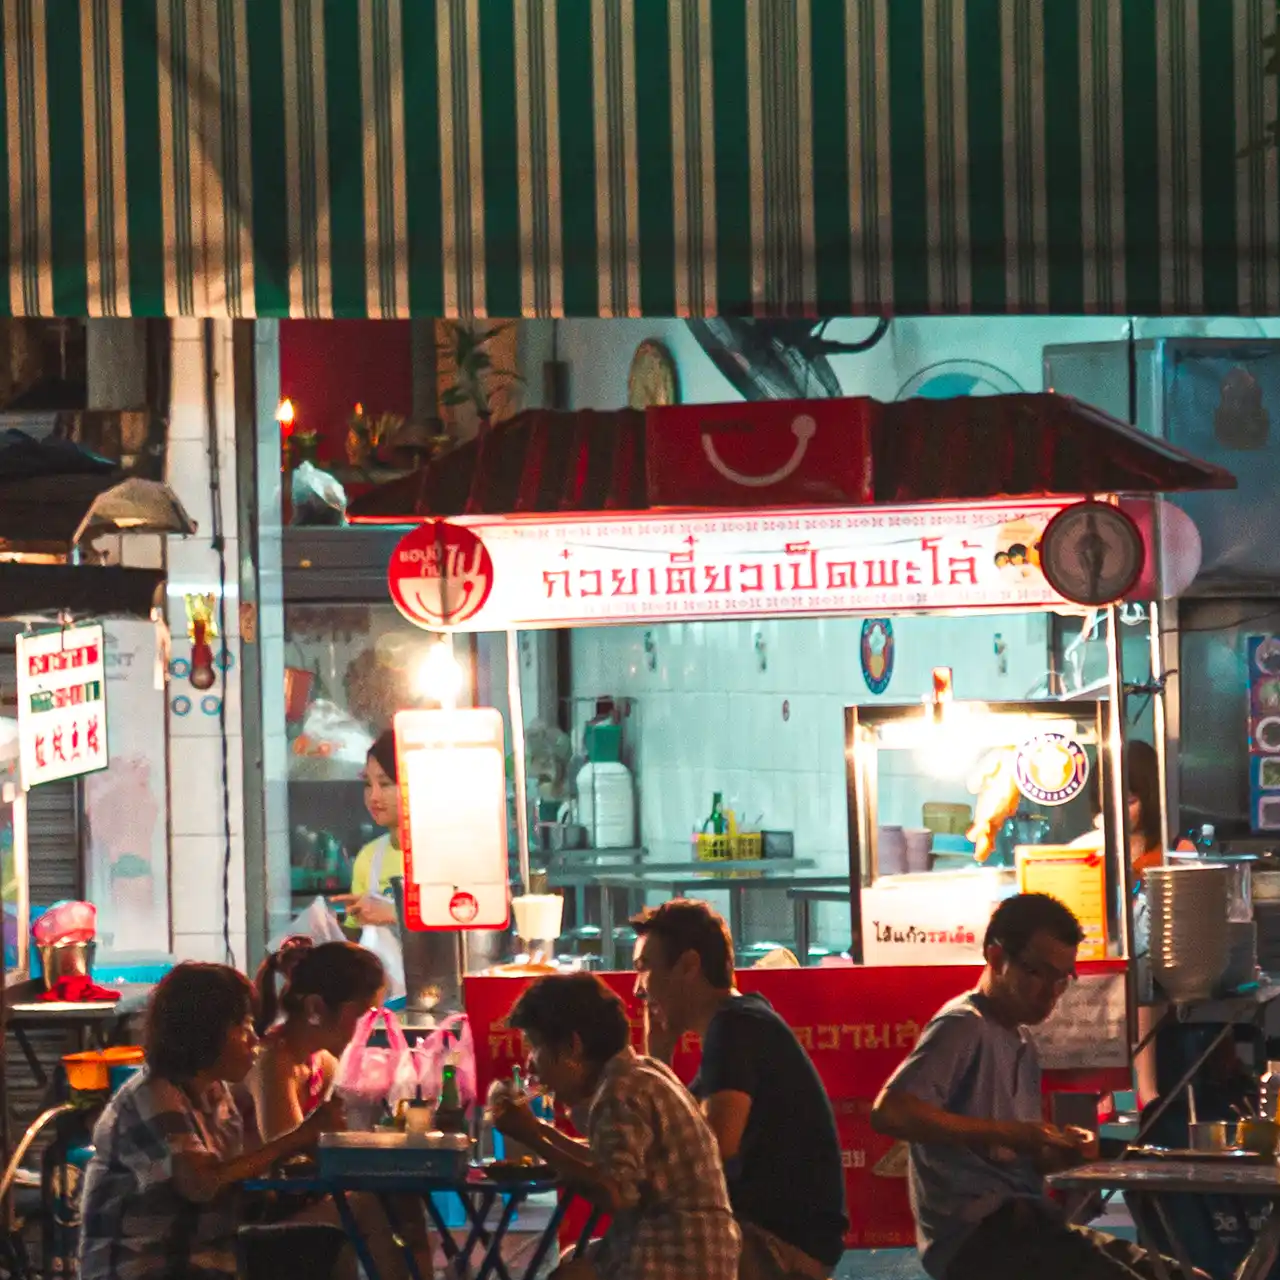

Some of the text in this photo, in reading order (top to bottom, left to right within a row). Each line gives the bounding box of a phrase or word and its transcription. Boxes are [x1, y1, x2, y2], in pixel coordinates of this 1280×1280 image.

[542, 535, 983, 598] ก๋วยเตี๋ยวเป็ดพะโล้
